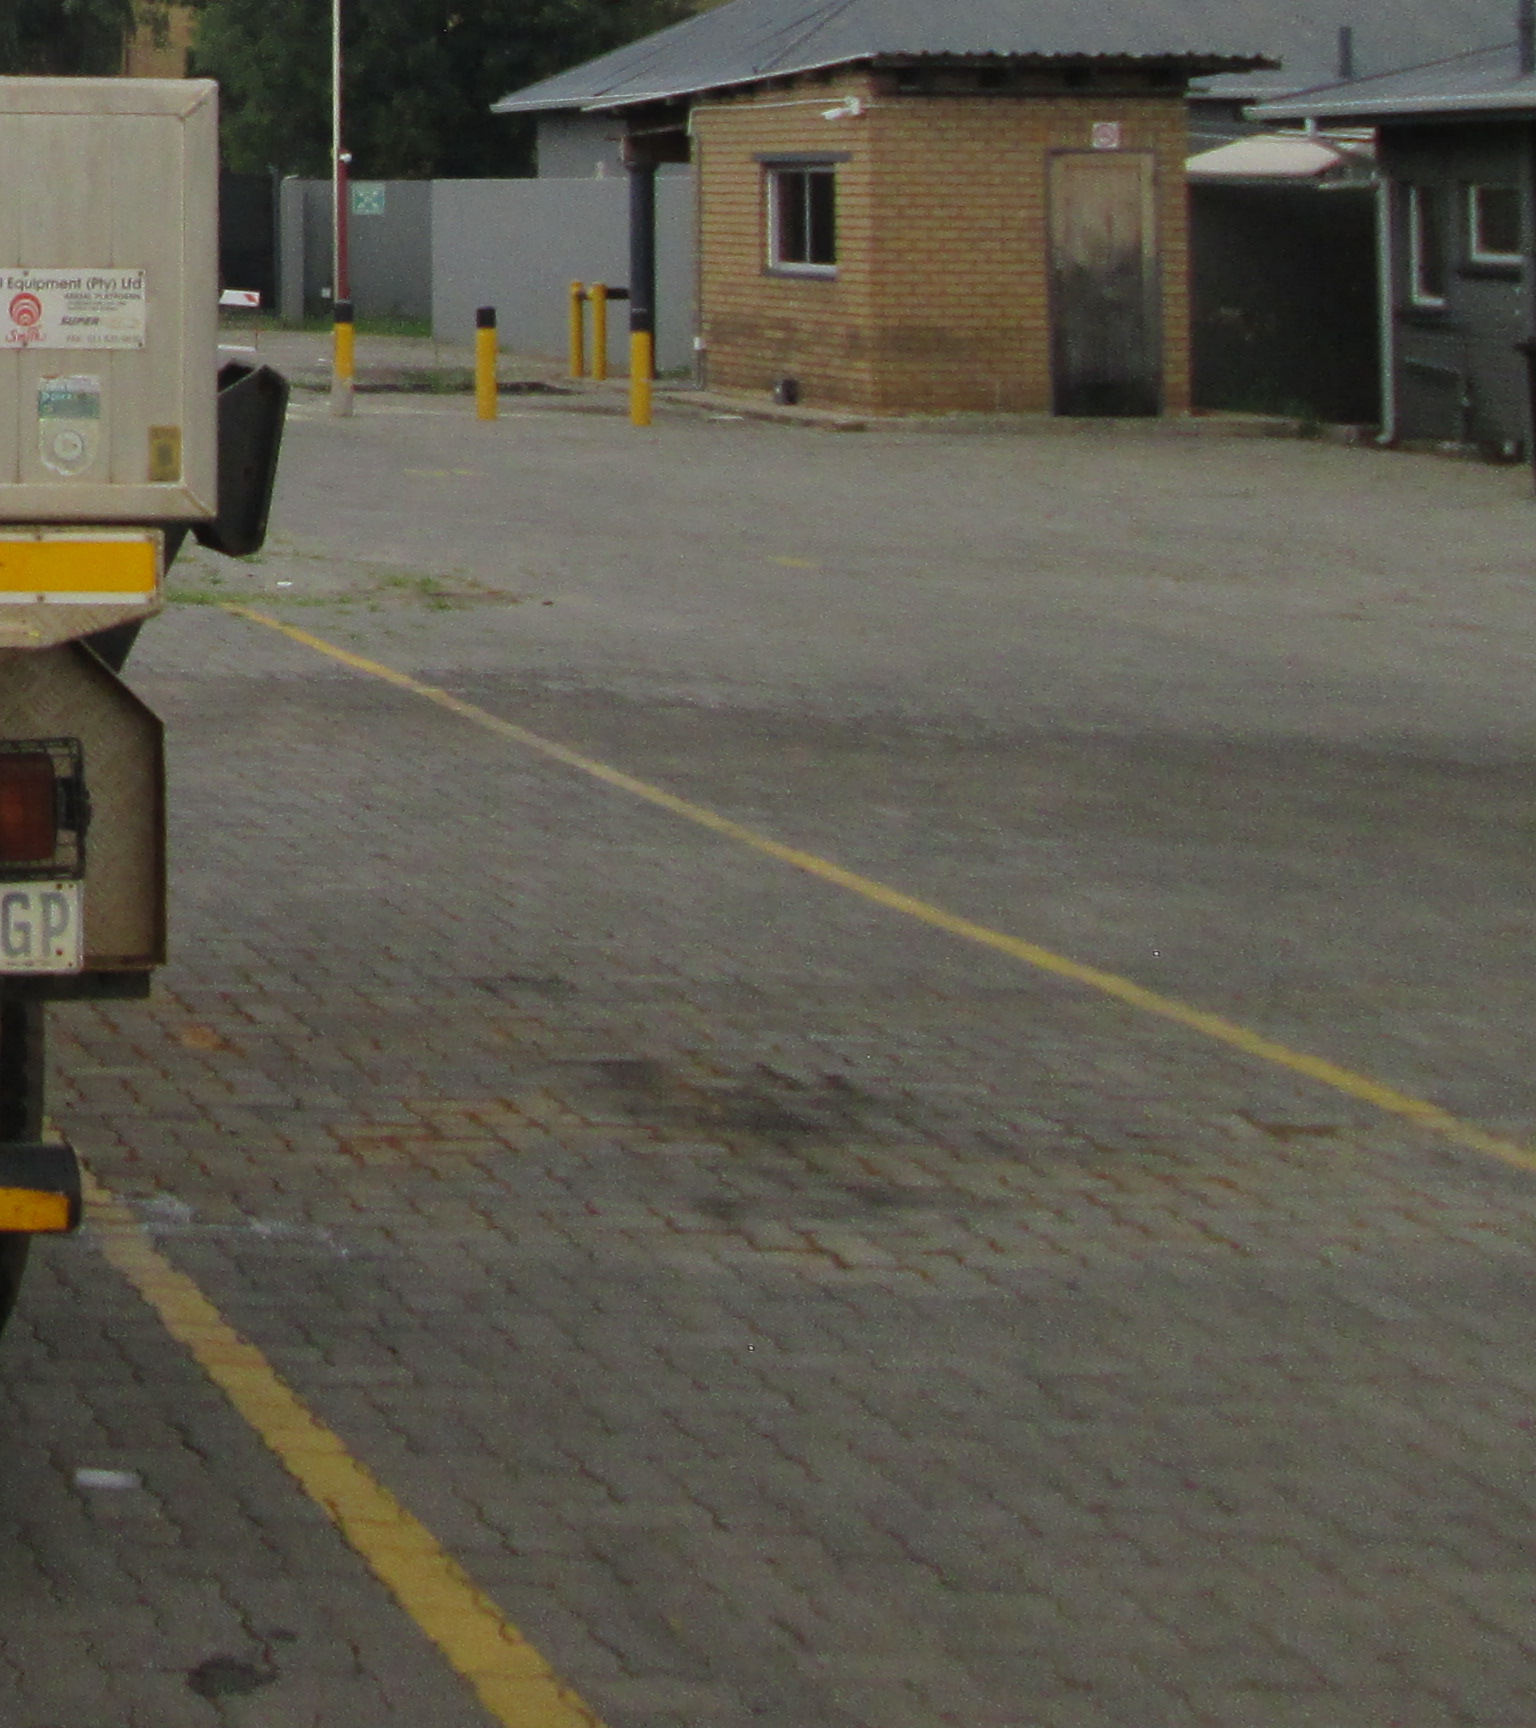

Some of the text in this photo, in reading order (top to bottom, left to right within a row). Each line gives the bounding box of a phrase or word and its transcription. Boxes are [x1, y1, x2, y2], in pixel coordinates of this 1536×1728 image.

[7, 277, 82, 291] Equipment
[86, 277, 117, 292] (Pty)
[121, 277, 142, 290] Ltd
[1, 891, 70, 960] GP
